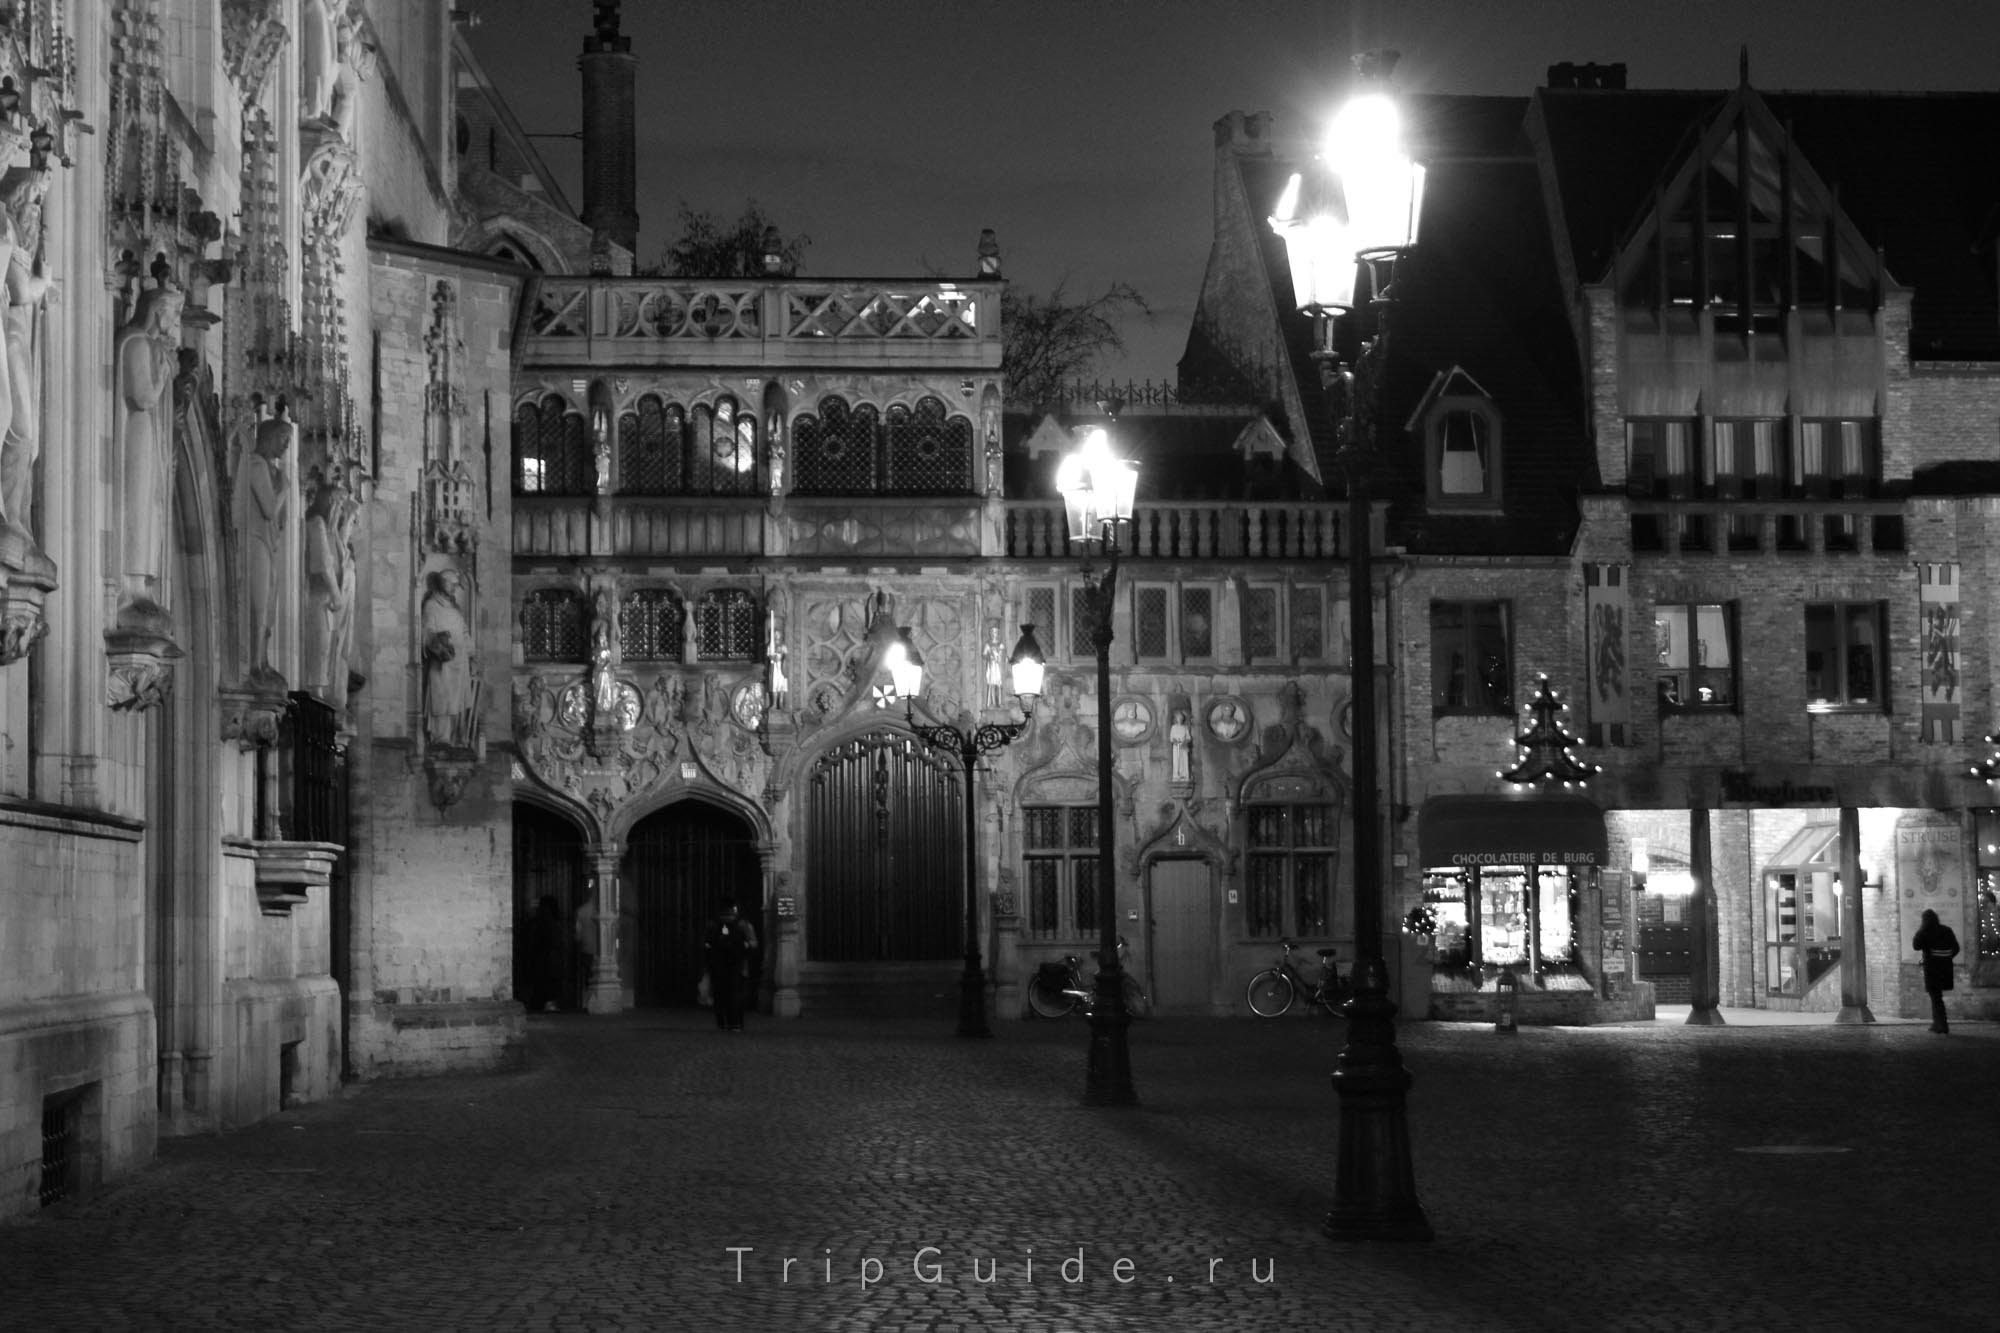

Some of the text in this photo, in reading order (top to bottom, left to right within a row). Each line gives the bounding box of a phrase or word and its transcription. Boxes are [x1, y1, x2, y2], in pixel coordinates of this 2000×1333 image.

[1900, 830, 1957, 844] STRUISE
[1452, 852, 1595, 865] CHOCOLATERIE DE BURG
